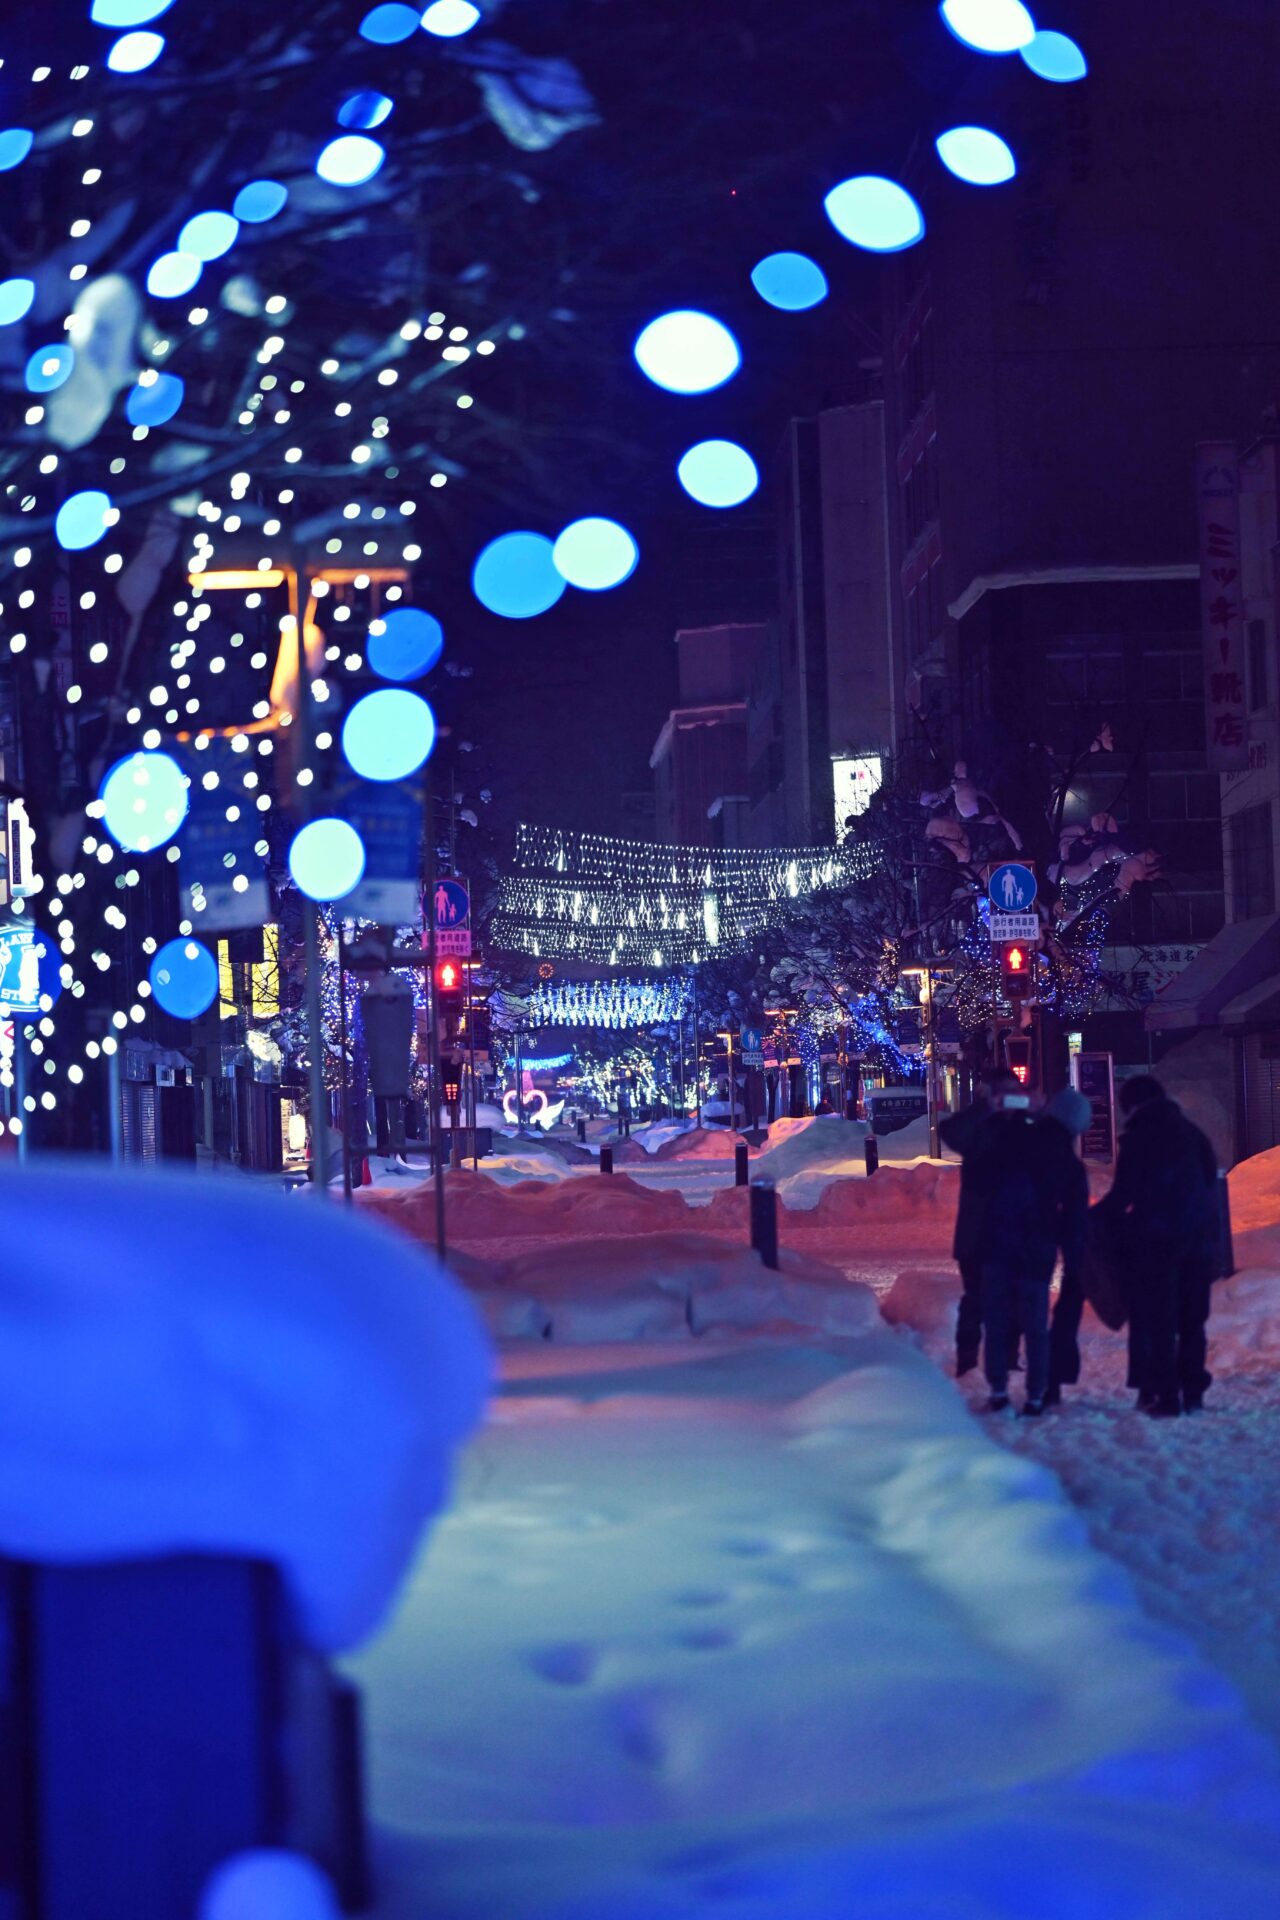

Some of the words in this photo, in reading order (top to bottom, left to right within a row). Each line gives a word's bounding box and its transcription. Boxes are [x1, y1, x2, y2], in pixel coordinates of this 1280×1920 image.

[1207, 522, 1243, 747] ミッキー靴店
[993, 917, 1035, 928] 歩行者用道路
